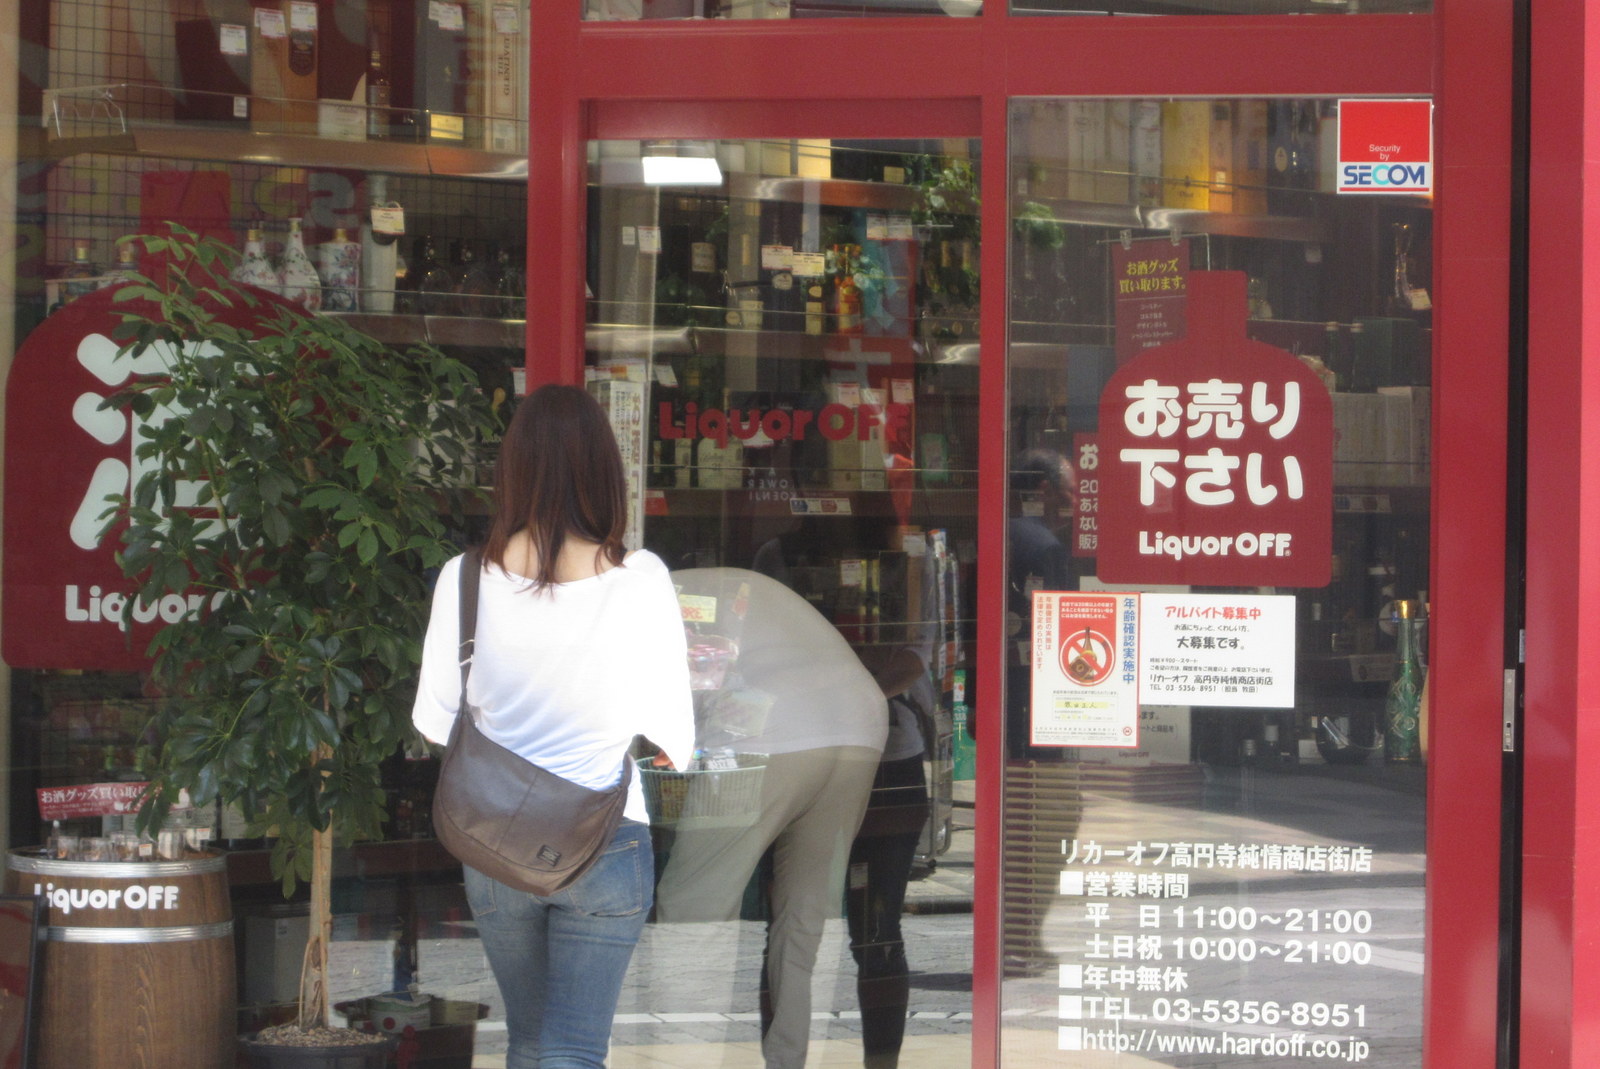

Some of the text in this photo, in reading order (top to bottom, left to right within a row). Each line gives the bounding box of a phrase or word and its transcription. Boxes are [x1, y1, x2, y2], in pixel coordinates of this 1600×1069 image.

[1369, 144, 1401, 154] Security
[1380, 153, 1390, 161] by
[1344, 164, 1425, 185] SECOM
[1127, 257, 1179, 275] お酒グッズ
[1119, 275, 1186, 294] 買い取ります。
[1124, 378, 1300, 440] お売り
[1120, 448, 1304, 506] 下さい
[1165, 606, 1261, 620] アルバイト募集中
[1123, 598, 1135, 684] 年齢確認実施中
[1176, 636, 1244, 650] 大募集です。
[1193, 674, 1273, 686] 高円寺純情商店街店
[1060, 840, 1372, 873] リカーオフ高円寺純情商店街店
[1085, 871, 1189, 899] 営業時間
[1084, 934, 1163, 961] 土日祝
[1083, 964, 1189, 992] 年中無休
[1083, 1028, 1370, 1062] http://www.hardoff.co.jp
